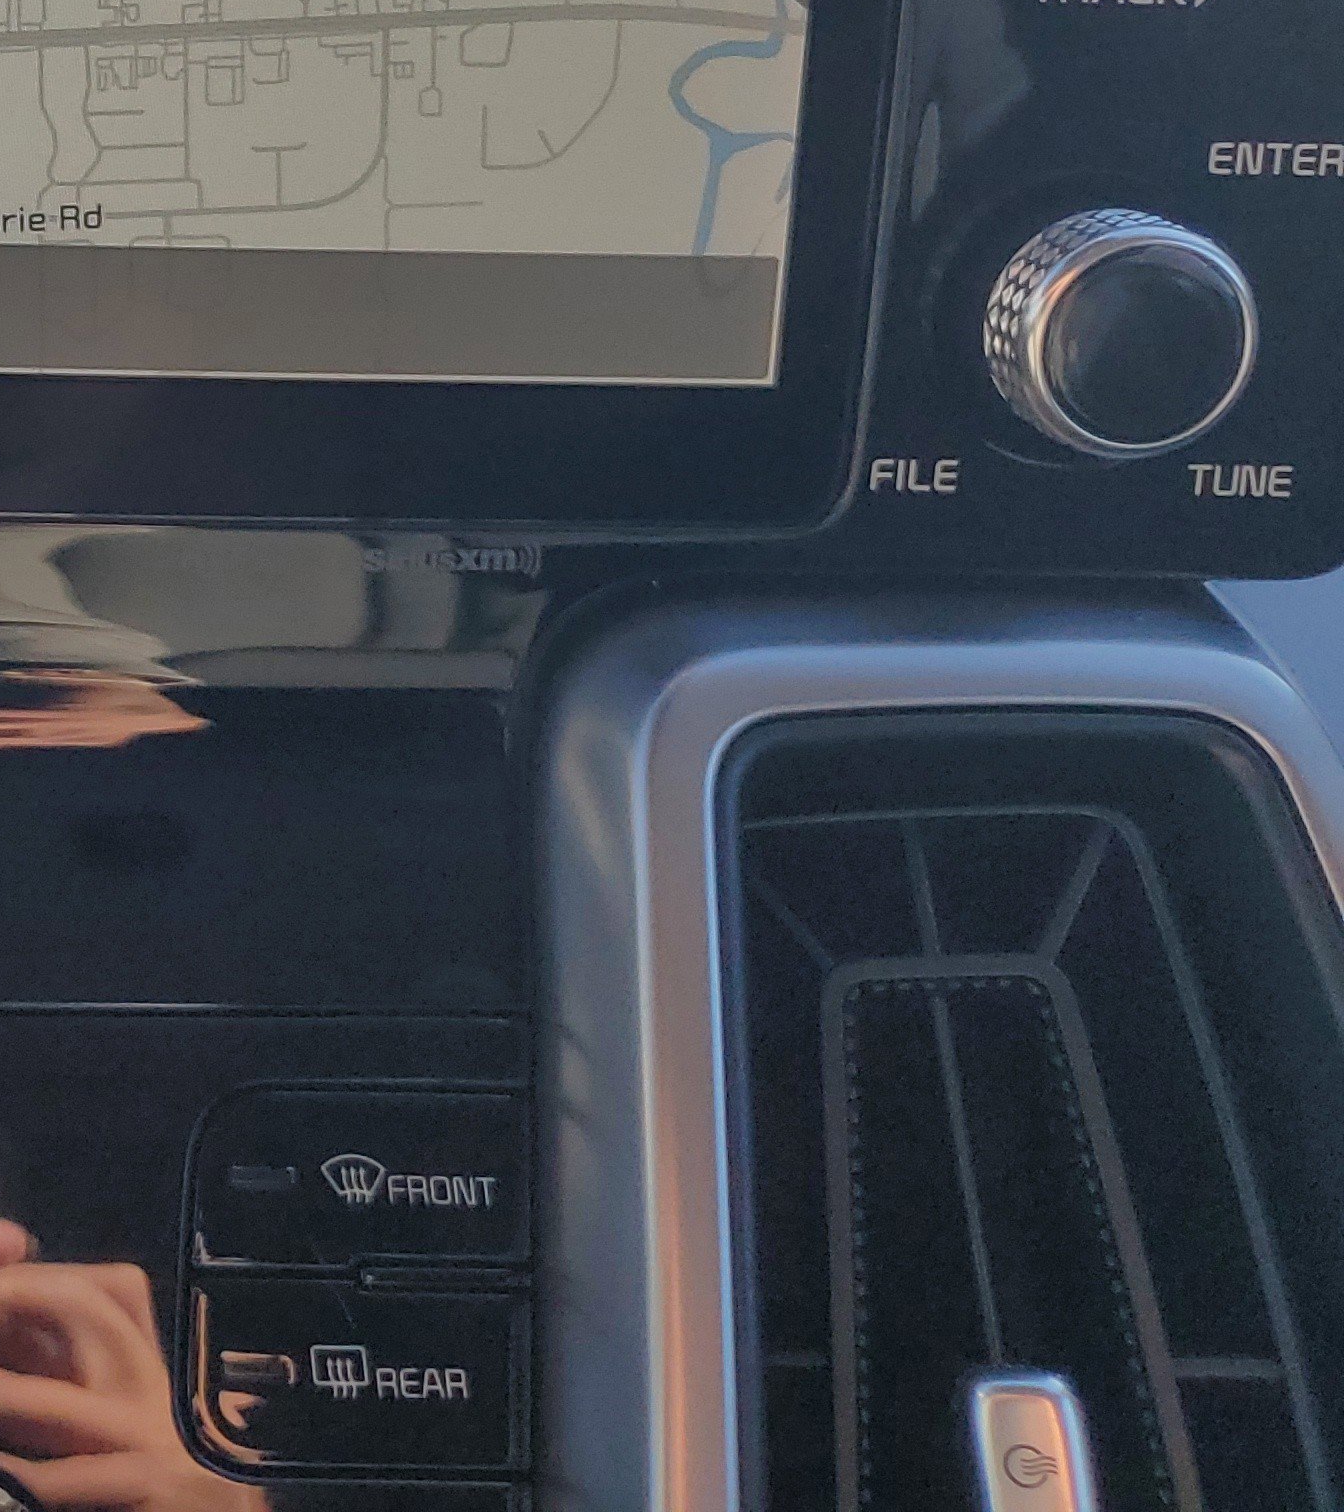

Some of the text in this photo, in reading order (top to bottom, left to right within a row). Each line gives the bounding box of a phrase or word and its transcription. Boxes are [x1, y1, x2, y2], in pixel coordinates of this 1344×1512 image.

[1208, 141, 1344, 177] ENTER
[60, 204, 103, 231] Rd
[869, 458, 959, 493] FILE
[1188, 463, 1294, 498] TUNE
[387, 1174, 497, 1207] FRONT
[375, 1368, 469, 1399] REAR
